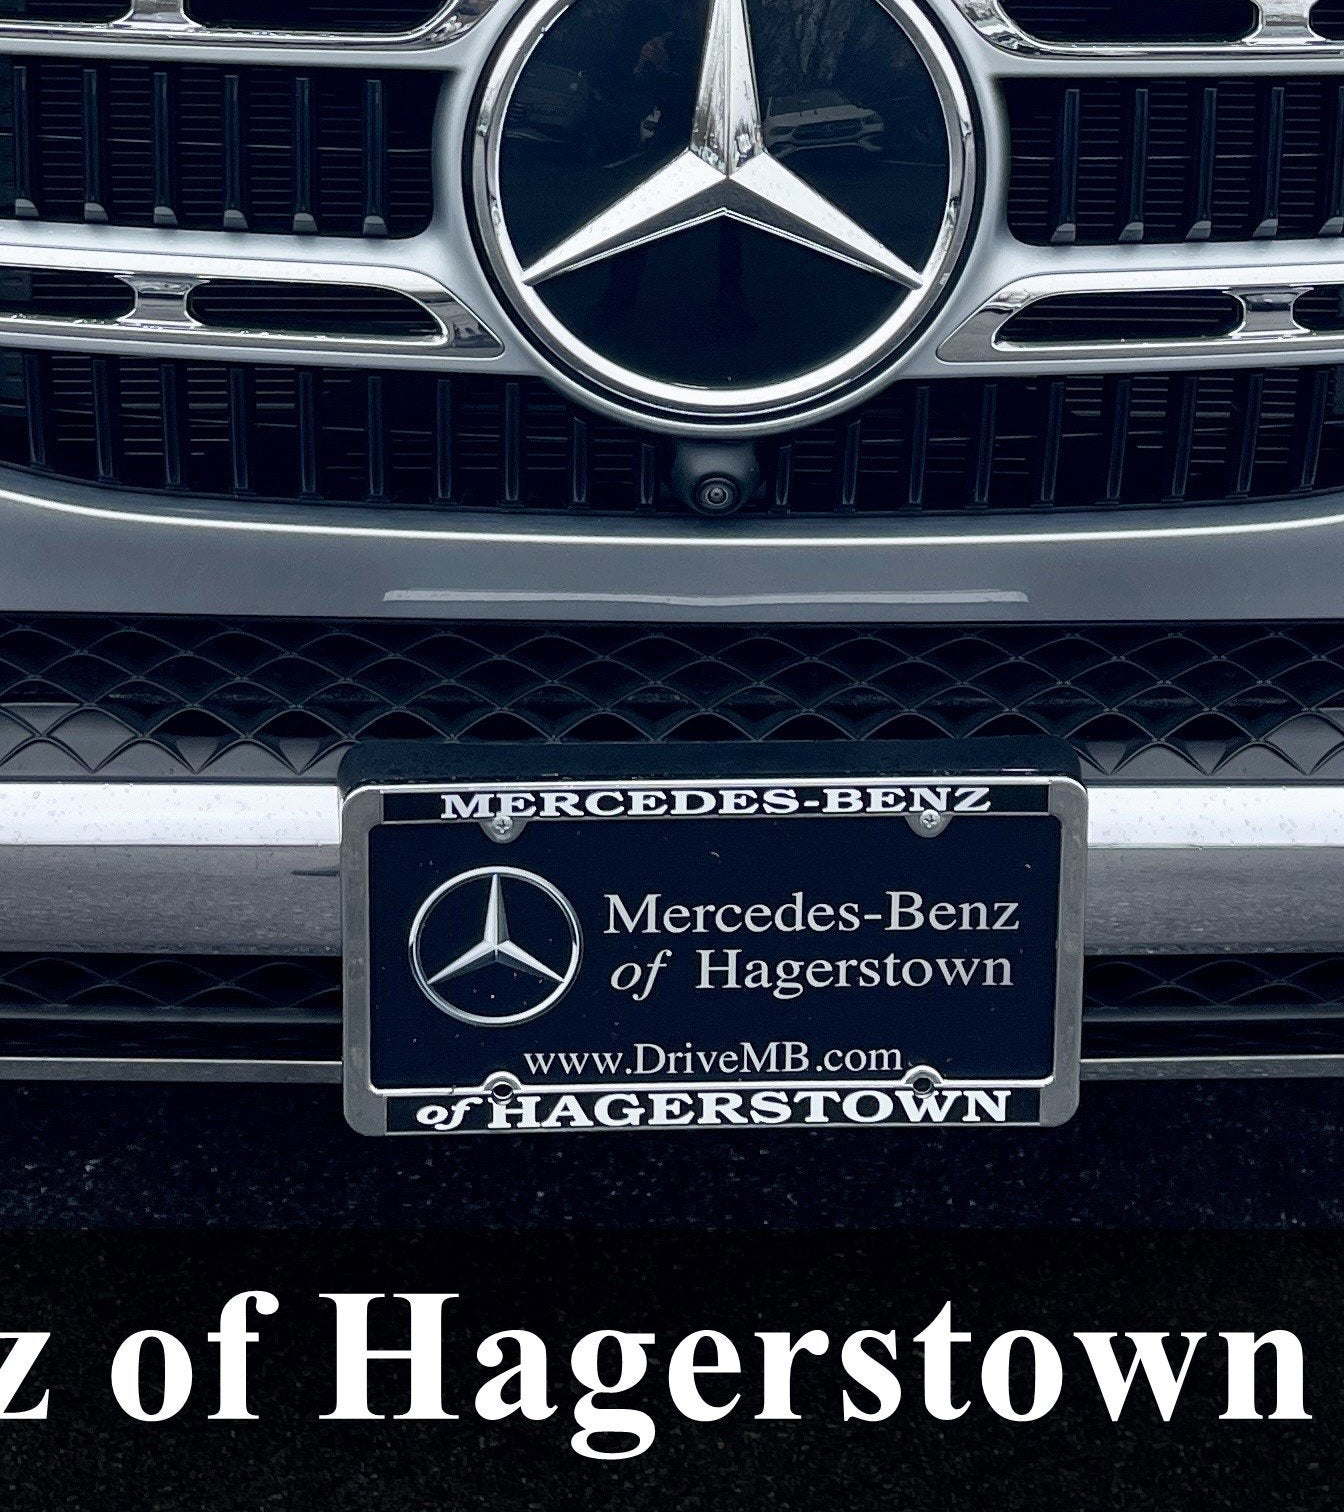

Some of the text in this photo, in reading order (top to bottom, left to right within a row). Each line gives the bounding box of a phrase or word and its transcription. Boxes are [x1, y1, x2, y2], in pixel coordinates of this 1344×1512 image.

[440, 786, 993, 819] MERCEDES-BENZ
[603, 890, 1021, 934] Mercedes-Benz
[610, 949, 1014, 1001] of Hagerstown
[523, 1042, 904, 1076] www.DriveMB.com
[416, 1090, 1011, 1131] of HAGERSTOWN
